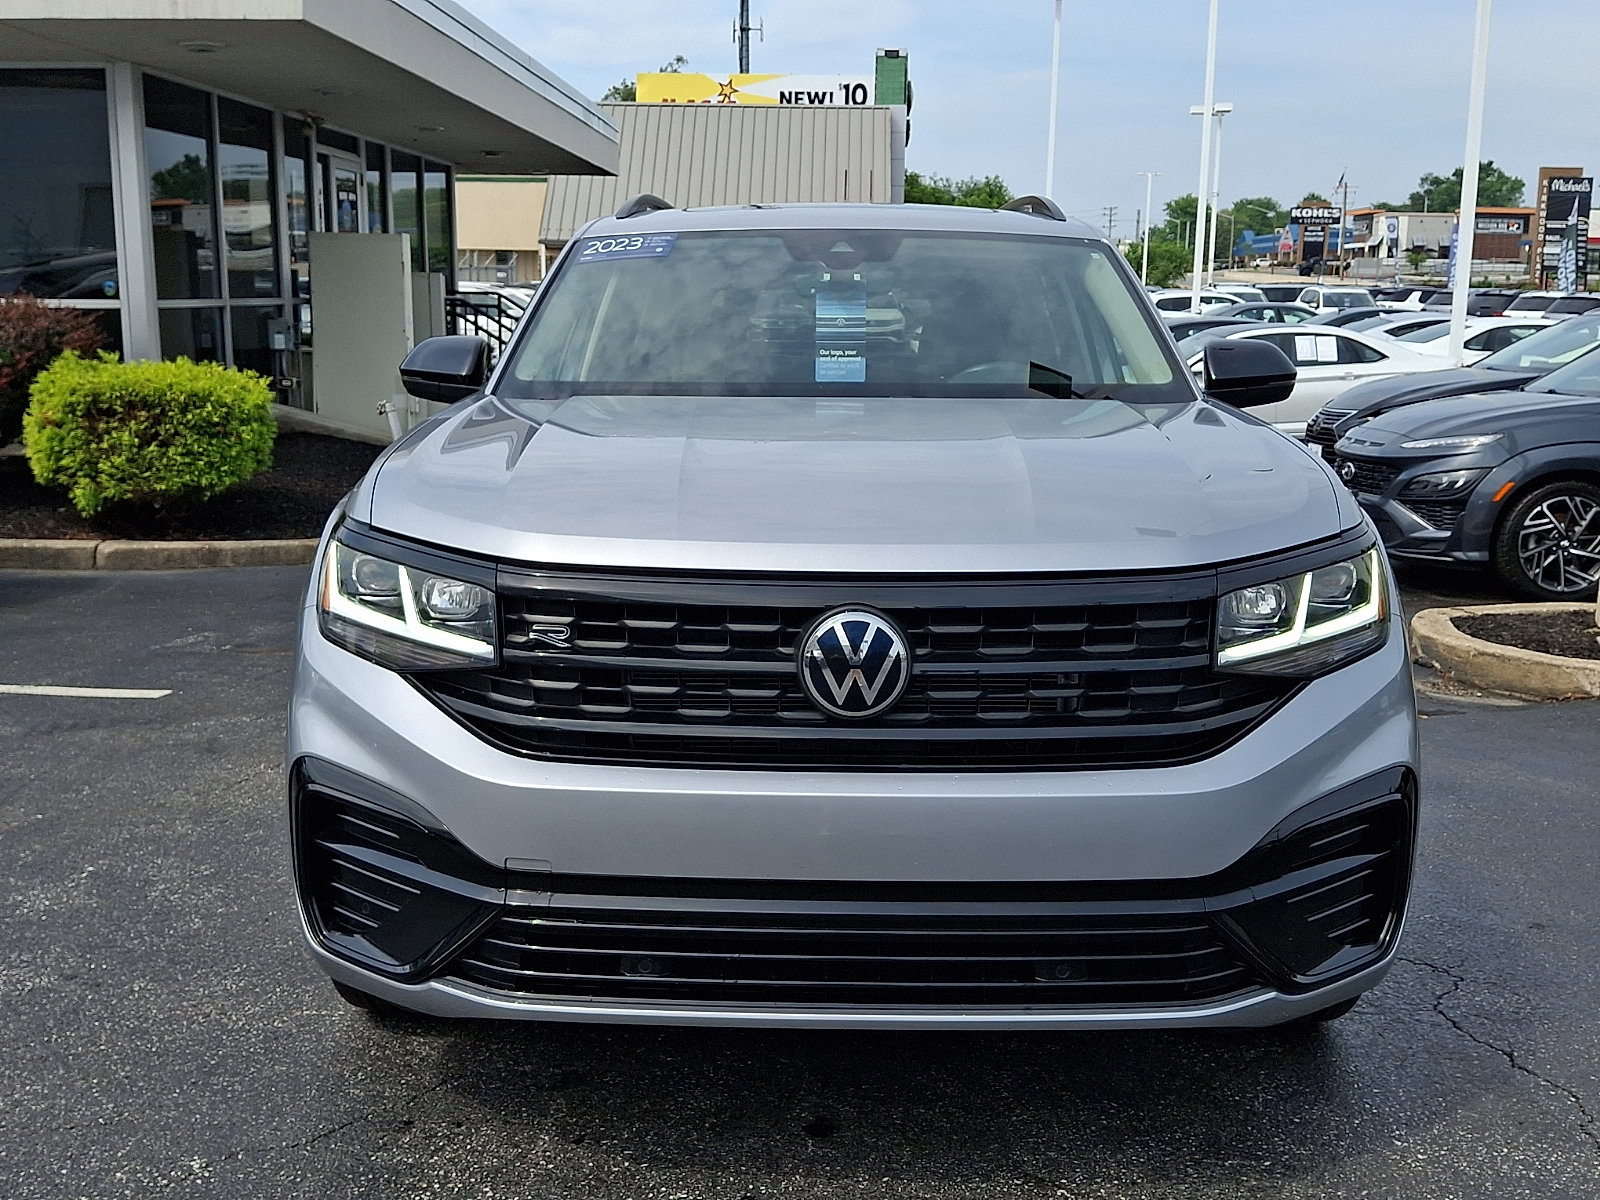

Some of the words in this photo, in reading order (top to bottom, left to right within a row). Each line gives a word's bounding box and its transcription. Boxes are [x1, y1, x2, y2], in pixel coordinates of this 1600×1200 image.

[779, 91, 834, 105] NEW!
[1551, 178, 1591, 192] Michaels
[583, 237, 644, 255] 2023
